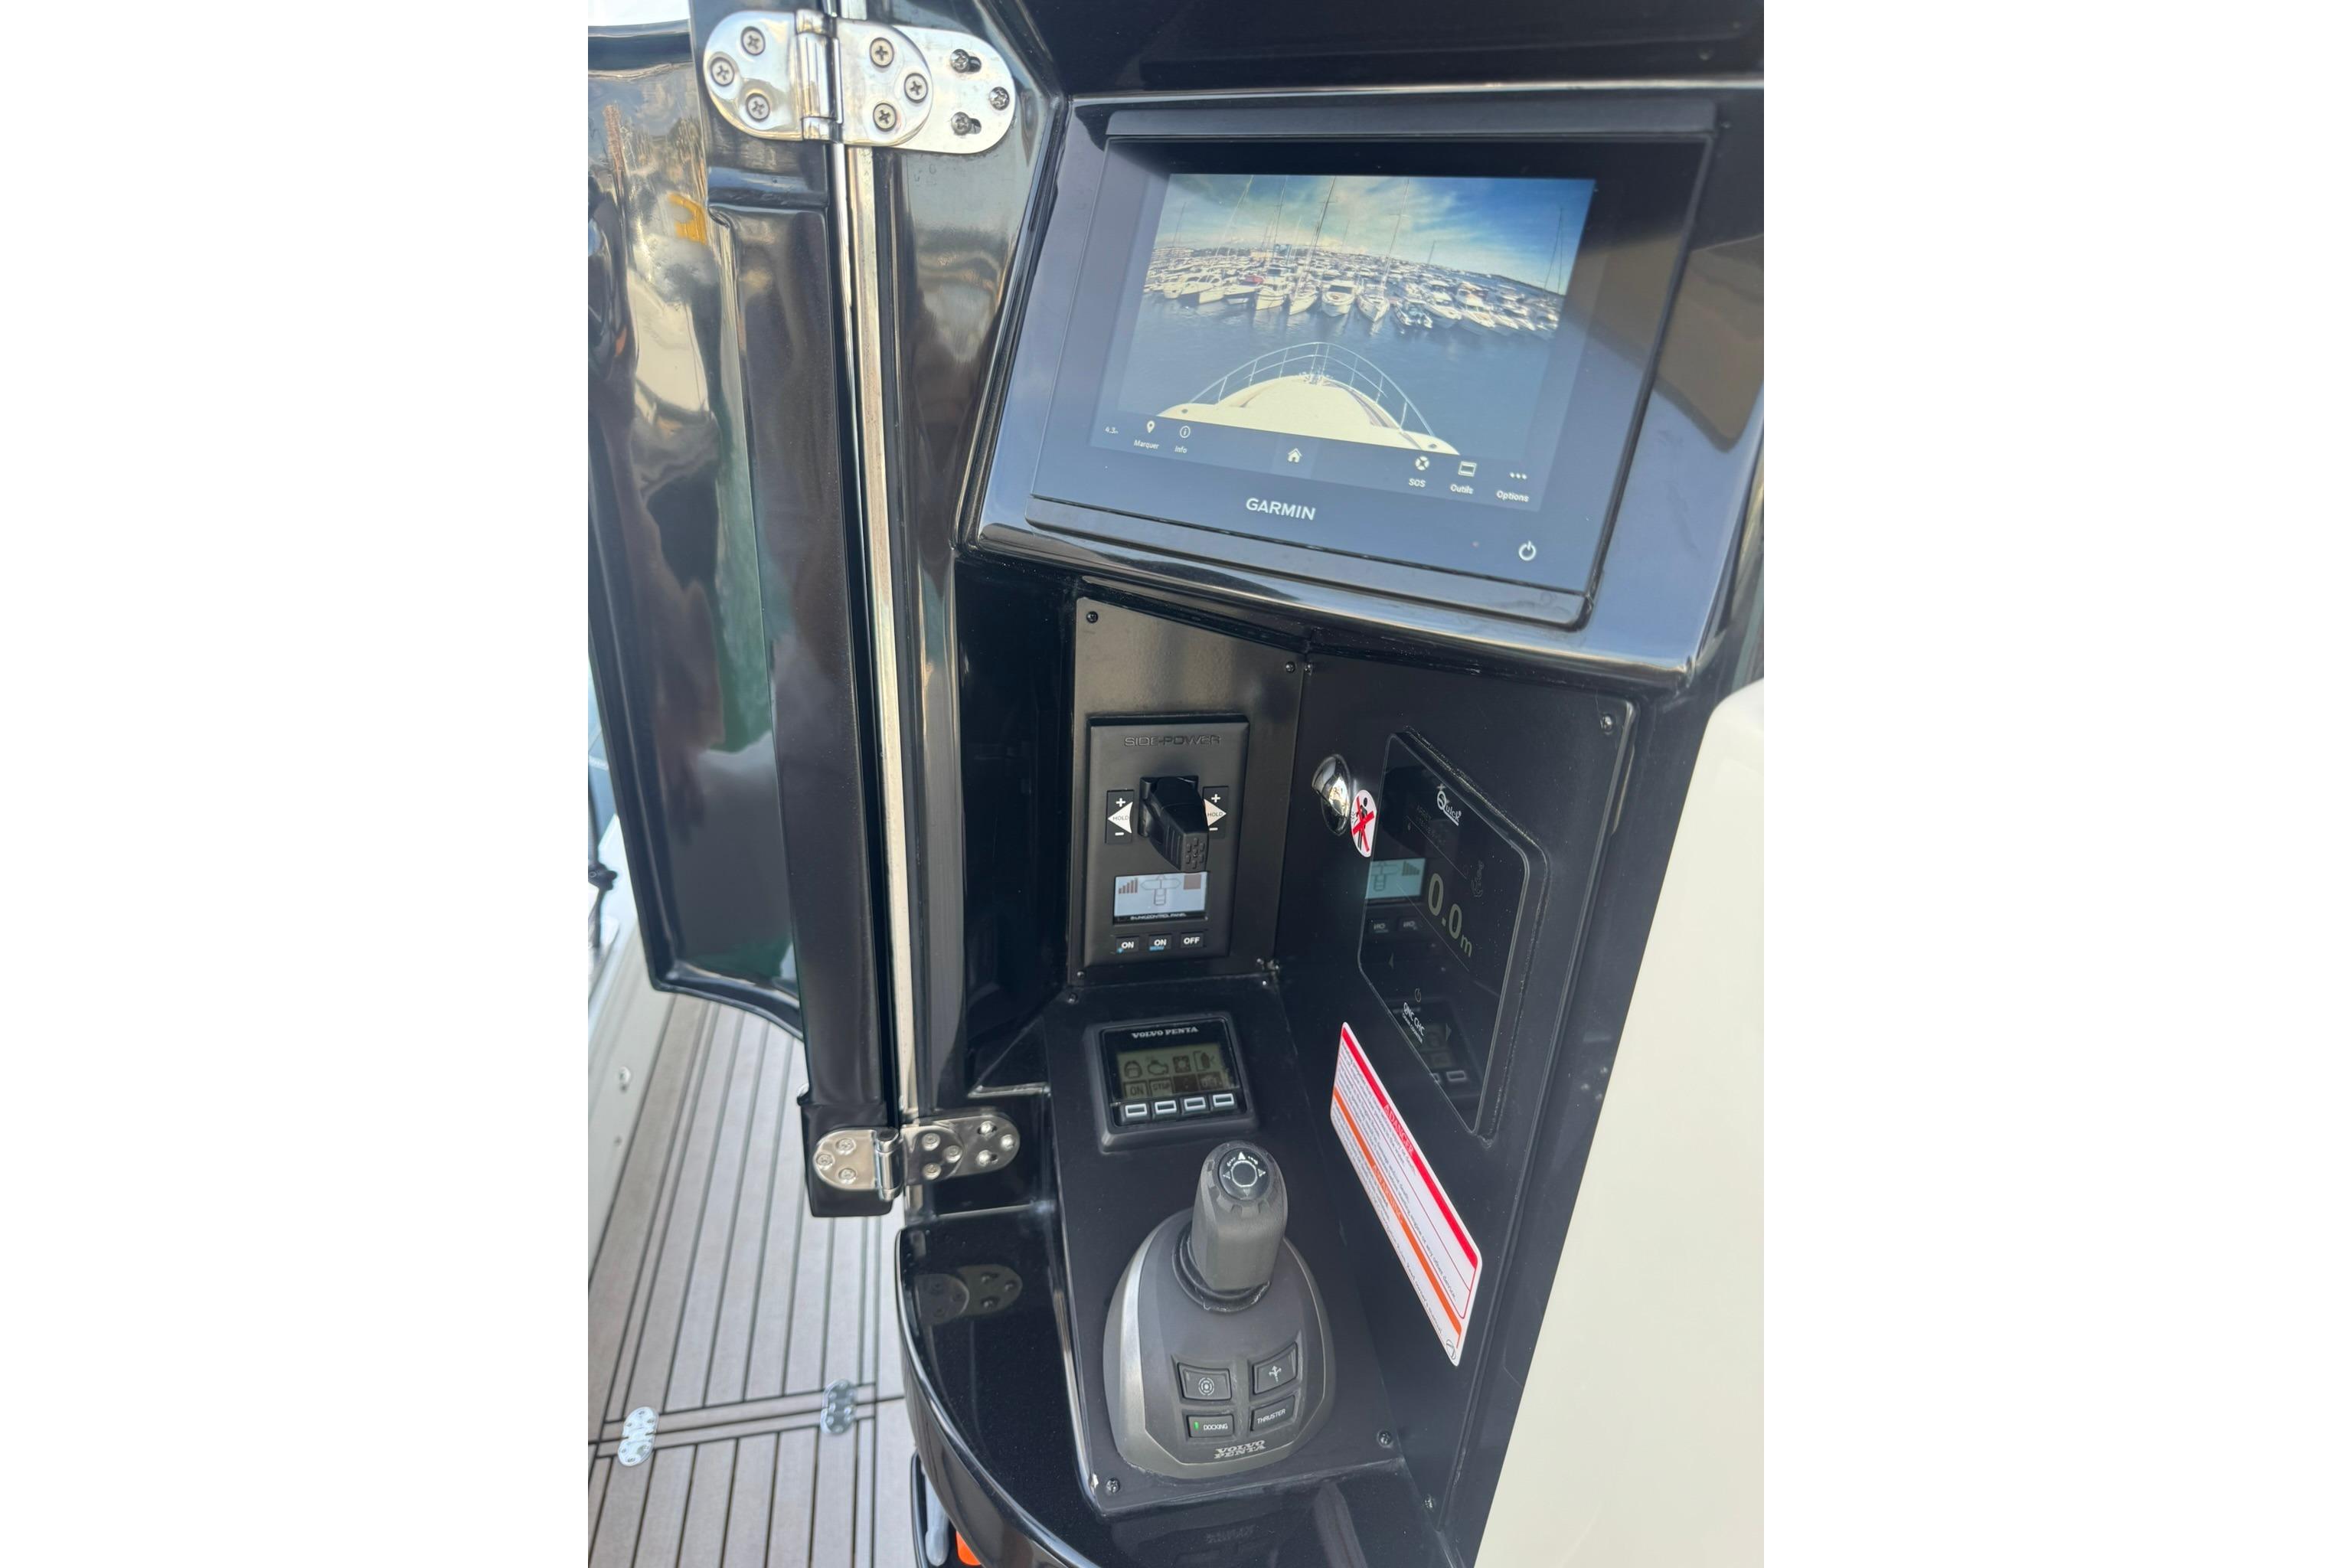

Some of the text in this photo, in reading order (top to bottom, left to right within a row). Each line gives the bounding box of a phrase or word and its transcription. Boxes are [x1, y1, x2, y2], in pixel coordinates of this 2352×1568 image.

[1134, 440, 1160, 450] Marquer
[1409, 478, 1426, 488] SOS
[1450, 483, 1474, 495] Outils
[1496, 489, 1530, 503] Options
[1246, 497, 1316, 521] GARMIN
[1124, 735, 1221, 747] SIDE-POWER
[1437, 790, 1462, 826] Quick
[1121, 941, 1134, 949] ON
[1184, 936, 1200, 945] OFF
[1132, 1027, 1199, 1039] VOLVO PENTA
[1130, 1086, 1145, 1096] ON
[1257, 1409, 1286, 1424] THRUSTER
[1214, 1446, 1266, 1459] PENTA
[1215, 1440, 1265, 1453] VOLVO
